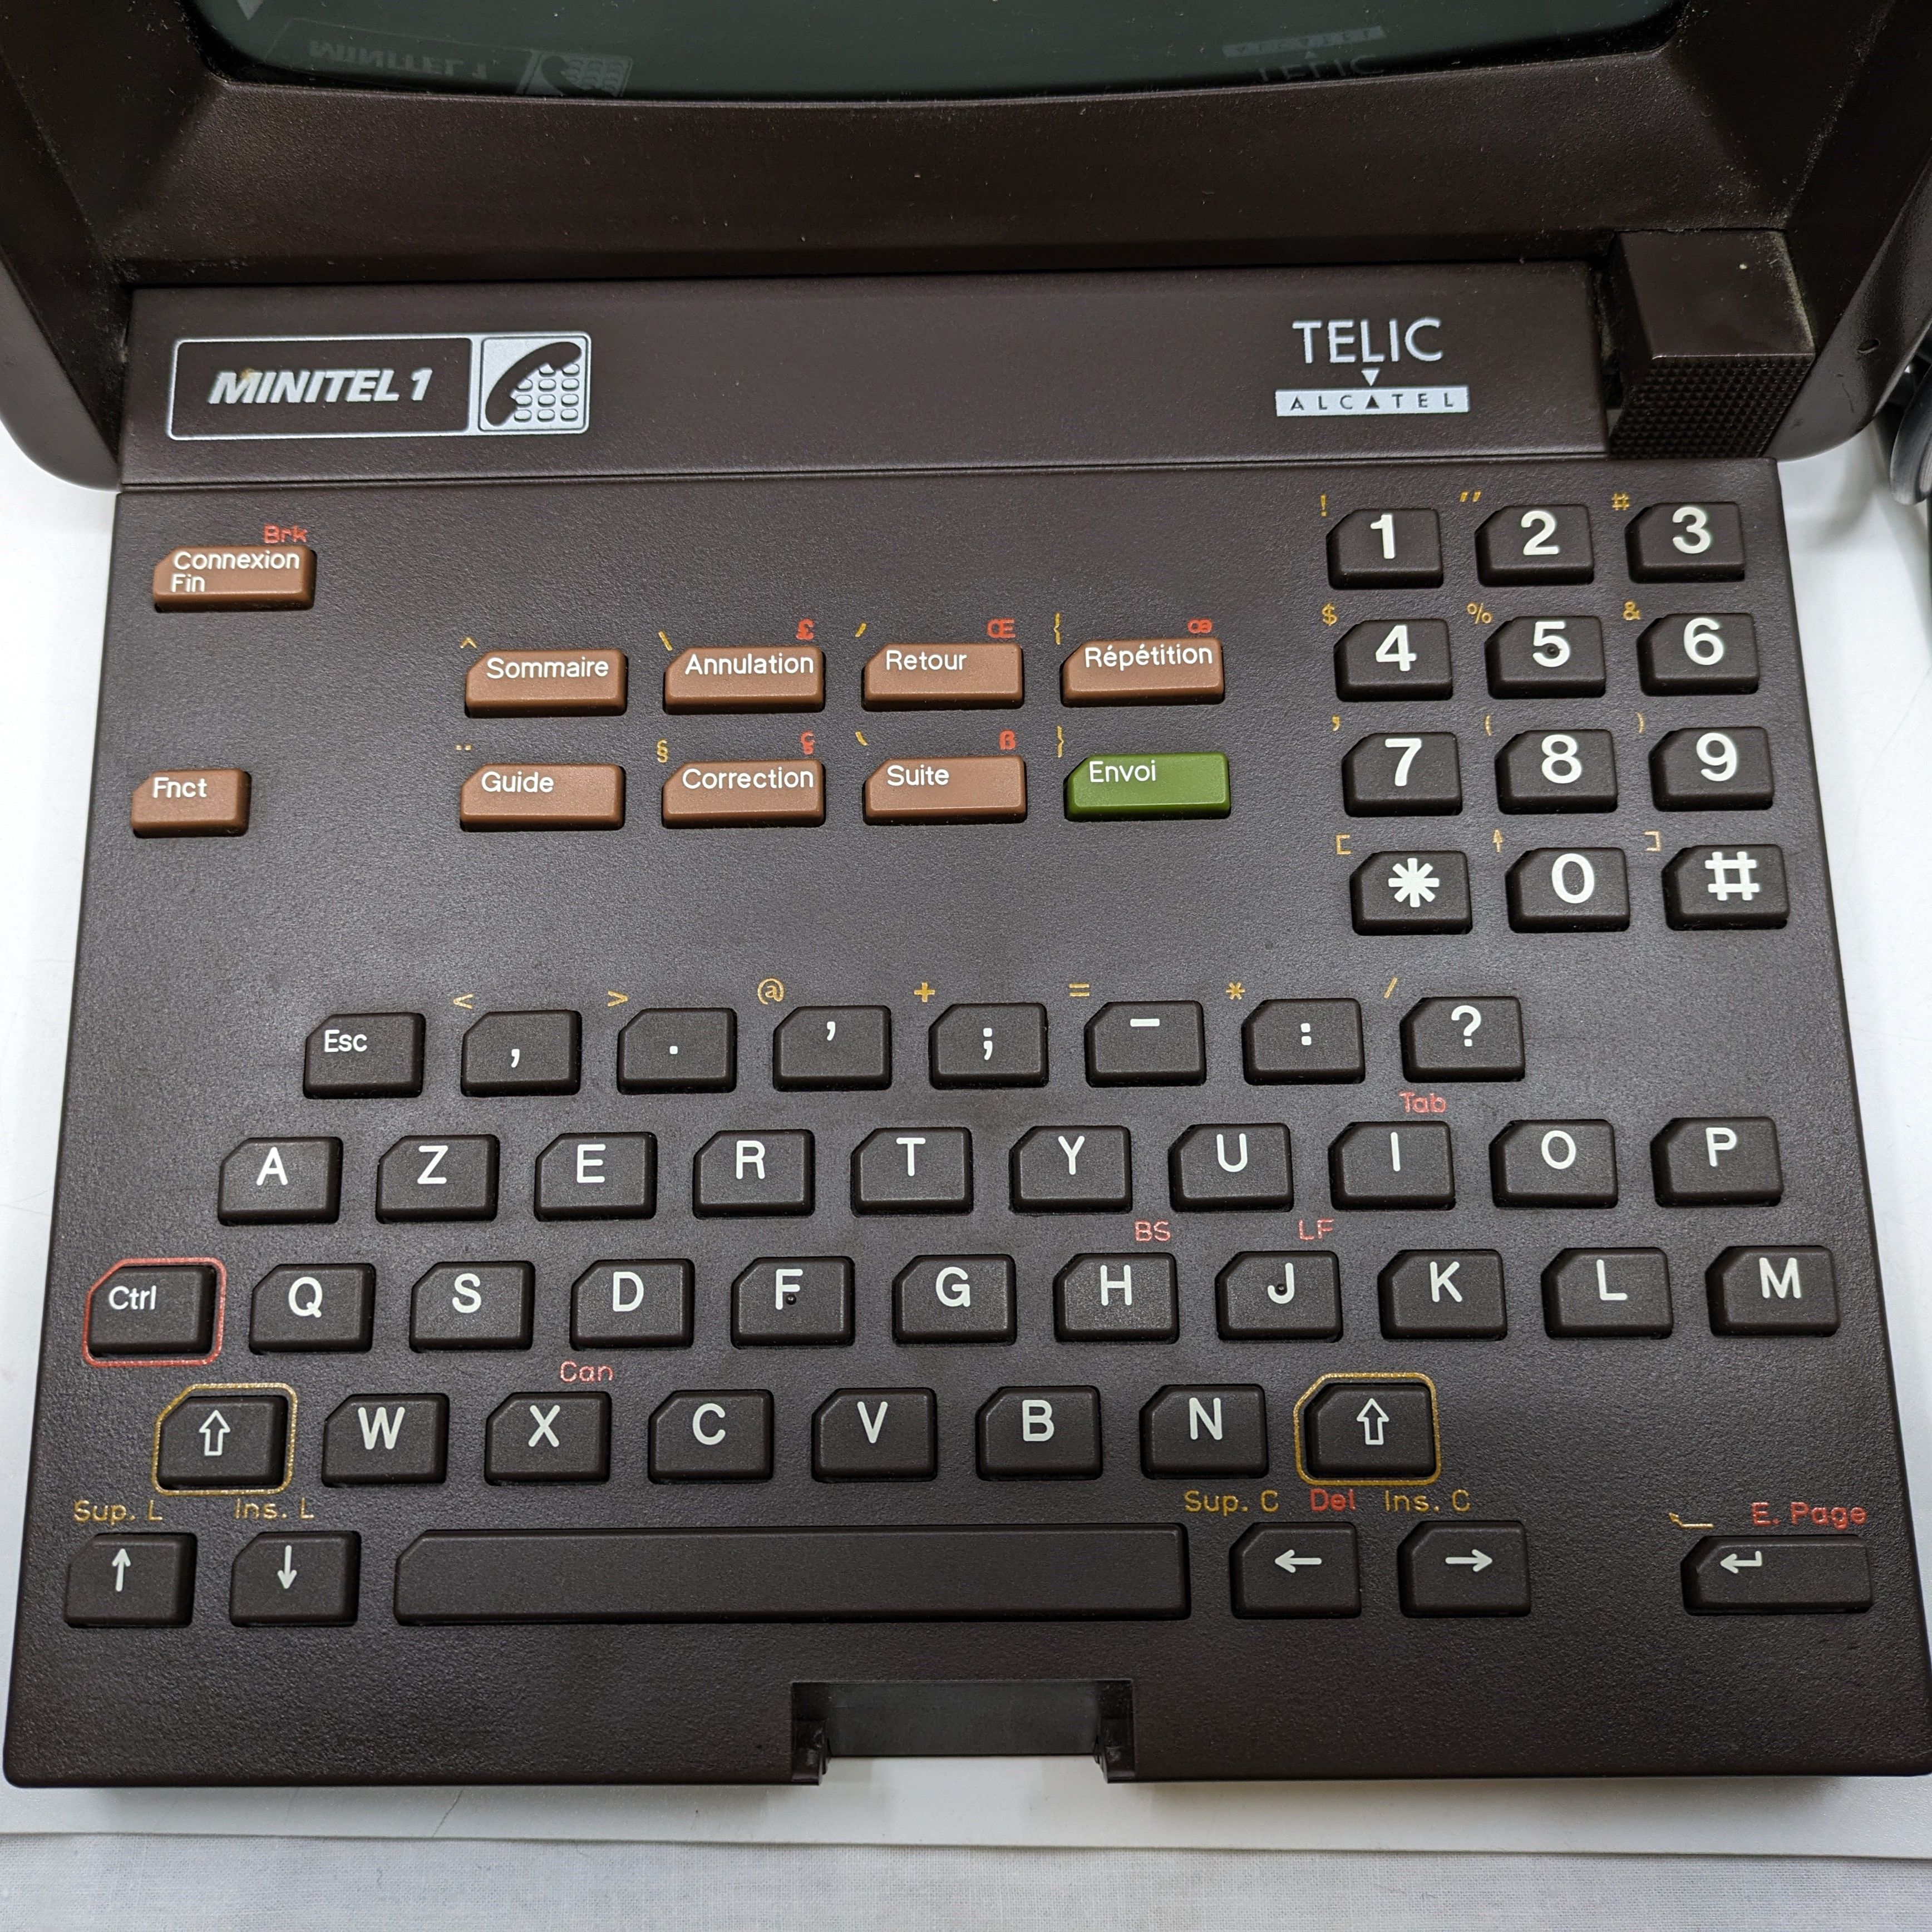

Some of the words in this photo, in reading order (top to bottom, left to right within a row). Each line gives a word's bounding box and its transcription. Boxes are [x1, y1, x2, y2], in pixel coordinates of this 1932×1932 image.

[1292, 317, 1442, 364] TELIC
[208, 369, 400, 404] MINITEL
[412, 368, 433, 401] 1
[1320, 494, 1327, 516] !
[1612, 493, 1630, 510] #
[263, 523, 308, 545] Brk
[1370, 514, 1396, 559] 1
[1521, 510, 1560, 555] 2
[1672, 506, 1711, 554] 3
[174, 550, 300, 570] Connexion
[171, 573, 205, 593] Fin
[795, 617, 815, 641] £
[1321, 604, 1338, 626] $
[1466, 603, 1492, 624] %
[1622, 602, 1641, 620] &
[886, 650, 967, 671] Retour
[1085, 643, 1213, 671] Répétition
[1375, 624, 1417, 672] 4
[1532, 620, 1571, 668] 5
[1683, 617, 1724, 666] 6
[487, 656, 609, 679] Sommaire
[685, 653, 814, 675] Annulation
[657, 739, 668, 762] §
[1384, 738, 1422, 787] 7
[1541, 734, 1583, 784] 8
[1696, 732, 1738, 782] 9
[152, 777, 208, 799] Fnct
[481, 771, 554, 793] Guide
[682, 766, 814, 789] Correction
[887, 764, 949, 786] Suite
[1090, 760, 1156, 782] Envoi
[1551, 853, 1595, 904] 0
[1704, 851, 1761, 901] #
[453, 993, 474, 1010] <
[608, 991, 628, 1007] >
[757, 978, 785, 1004] @
[914, 982, 935, 1001] +
[1068, 983, 1090, 997] =
[1384, 977, 1397, 999] /
[324, 1029, 368, 1053] Esc
[1451, 1005, 1482, 1047] ?
[1399, 1091, 1447, 1113] Tab
[255, 1145, 287, 1186] A
[417, 1145, 448, 1185] Z
[576, 1144, 606, 1184] E
[736, 1140, 766, 1180] R
[896, 1137, 926, 1176] T
[1058, 1135, 1085, 1175] Y
[1216, 1133, 1248, 1172] U
[1390, 1131, 1401, 1172] I
[1541, 1130, 1577, 1170] O
[1705, 1127, 1738, 1167] P
[1135, 1219, 1171, 1242] BS
[1298, 1218, 1333, 1241] LF
[108, 1285, 157, 1310] Ctrl
[288, 1276, 323, 1318] Q
[452, 1273, 482, 1314] S
[612, 1271, 644, 1312] D
[775, 1268, 804, 1310] F
[935, 1266, 971, 1307] G
[1100, 1264, 1132, 1307] H
[1267, 1262, 1295, 1304] J
[1430, 1261, 1463, 1303] K
[1596, 1259, 1628, 1301] L
[1759, 1257, 1801, 1299] M
[560, 1361, 614, 1383] Can
[357, 1406, 406, 1450] W
[528, 1404, 560, 1447] X
[692, 1403, 726, 1445] C
[857, 1401, 888, 1443] V
[1022, 1399, 1054, 1442] B
[1189, 1397, 1223, 1440] N
[73, 1500, 135, 1524] Sup.
[147, 1499, 163, 1521] L
[235, 1497, 287, 1519] Ins.
[300, 1497, 314, 1519] L
[1184, 1490, 1246, 1515] Sup.
[1260, 1490, 1278, 1512] C
[1309, 1487, 1356, 1512] Del
[1384, 1490, 1439, 1513] Ins.
[1452, 1490, 1470, 1512] C
[1751, 1502, 1780, 1526] E.
[1790, 1502, 1867, 1531] Page
